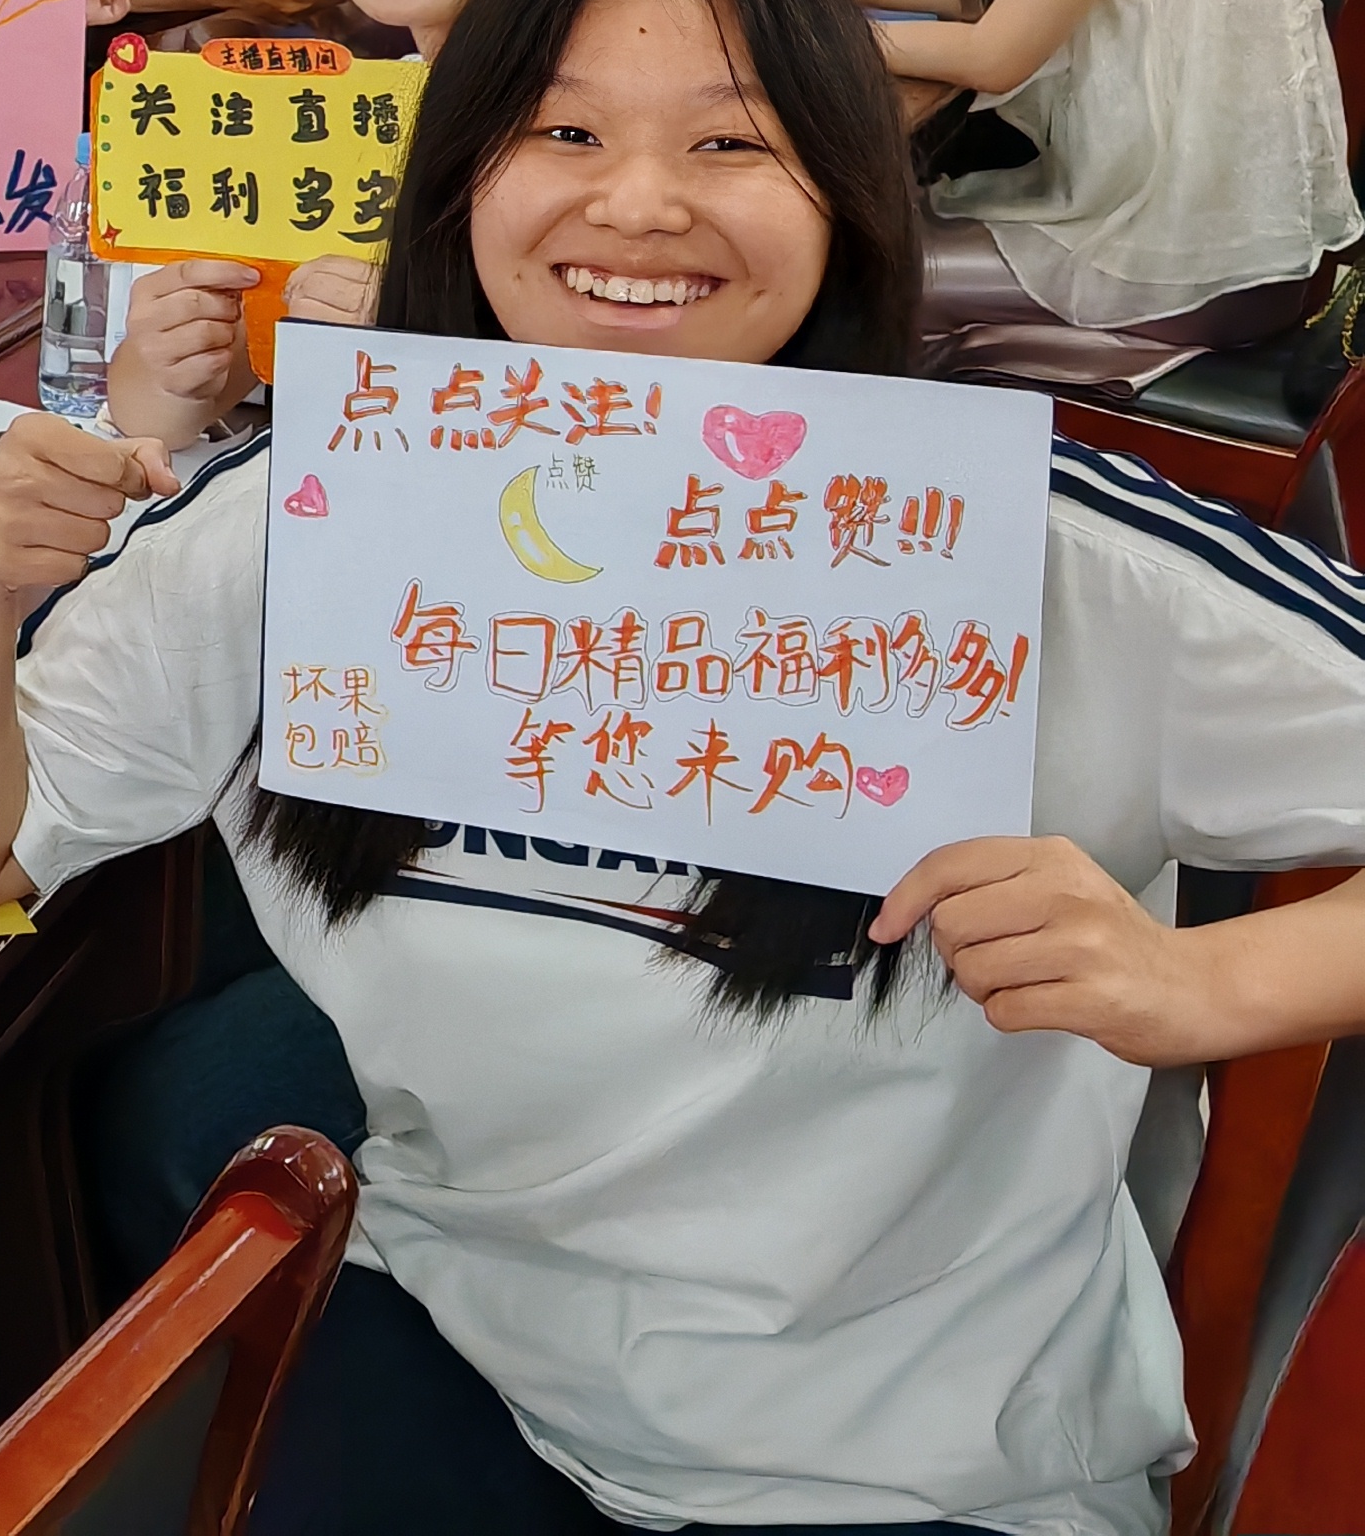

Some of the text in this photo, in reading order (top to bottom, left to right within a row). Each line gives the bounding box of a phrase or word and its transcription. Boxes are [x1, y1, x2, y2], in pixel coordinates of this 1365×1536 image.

[129, 82, 400, 144] 关注直播
[545, 452, 600, 493] 点赞
[282, 665, 382, 718] 坏果
[284, 720, 379, 769] 包赔
[503, 708, 855, 826] 等您来购
